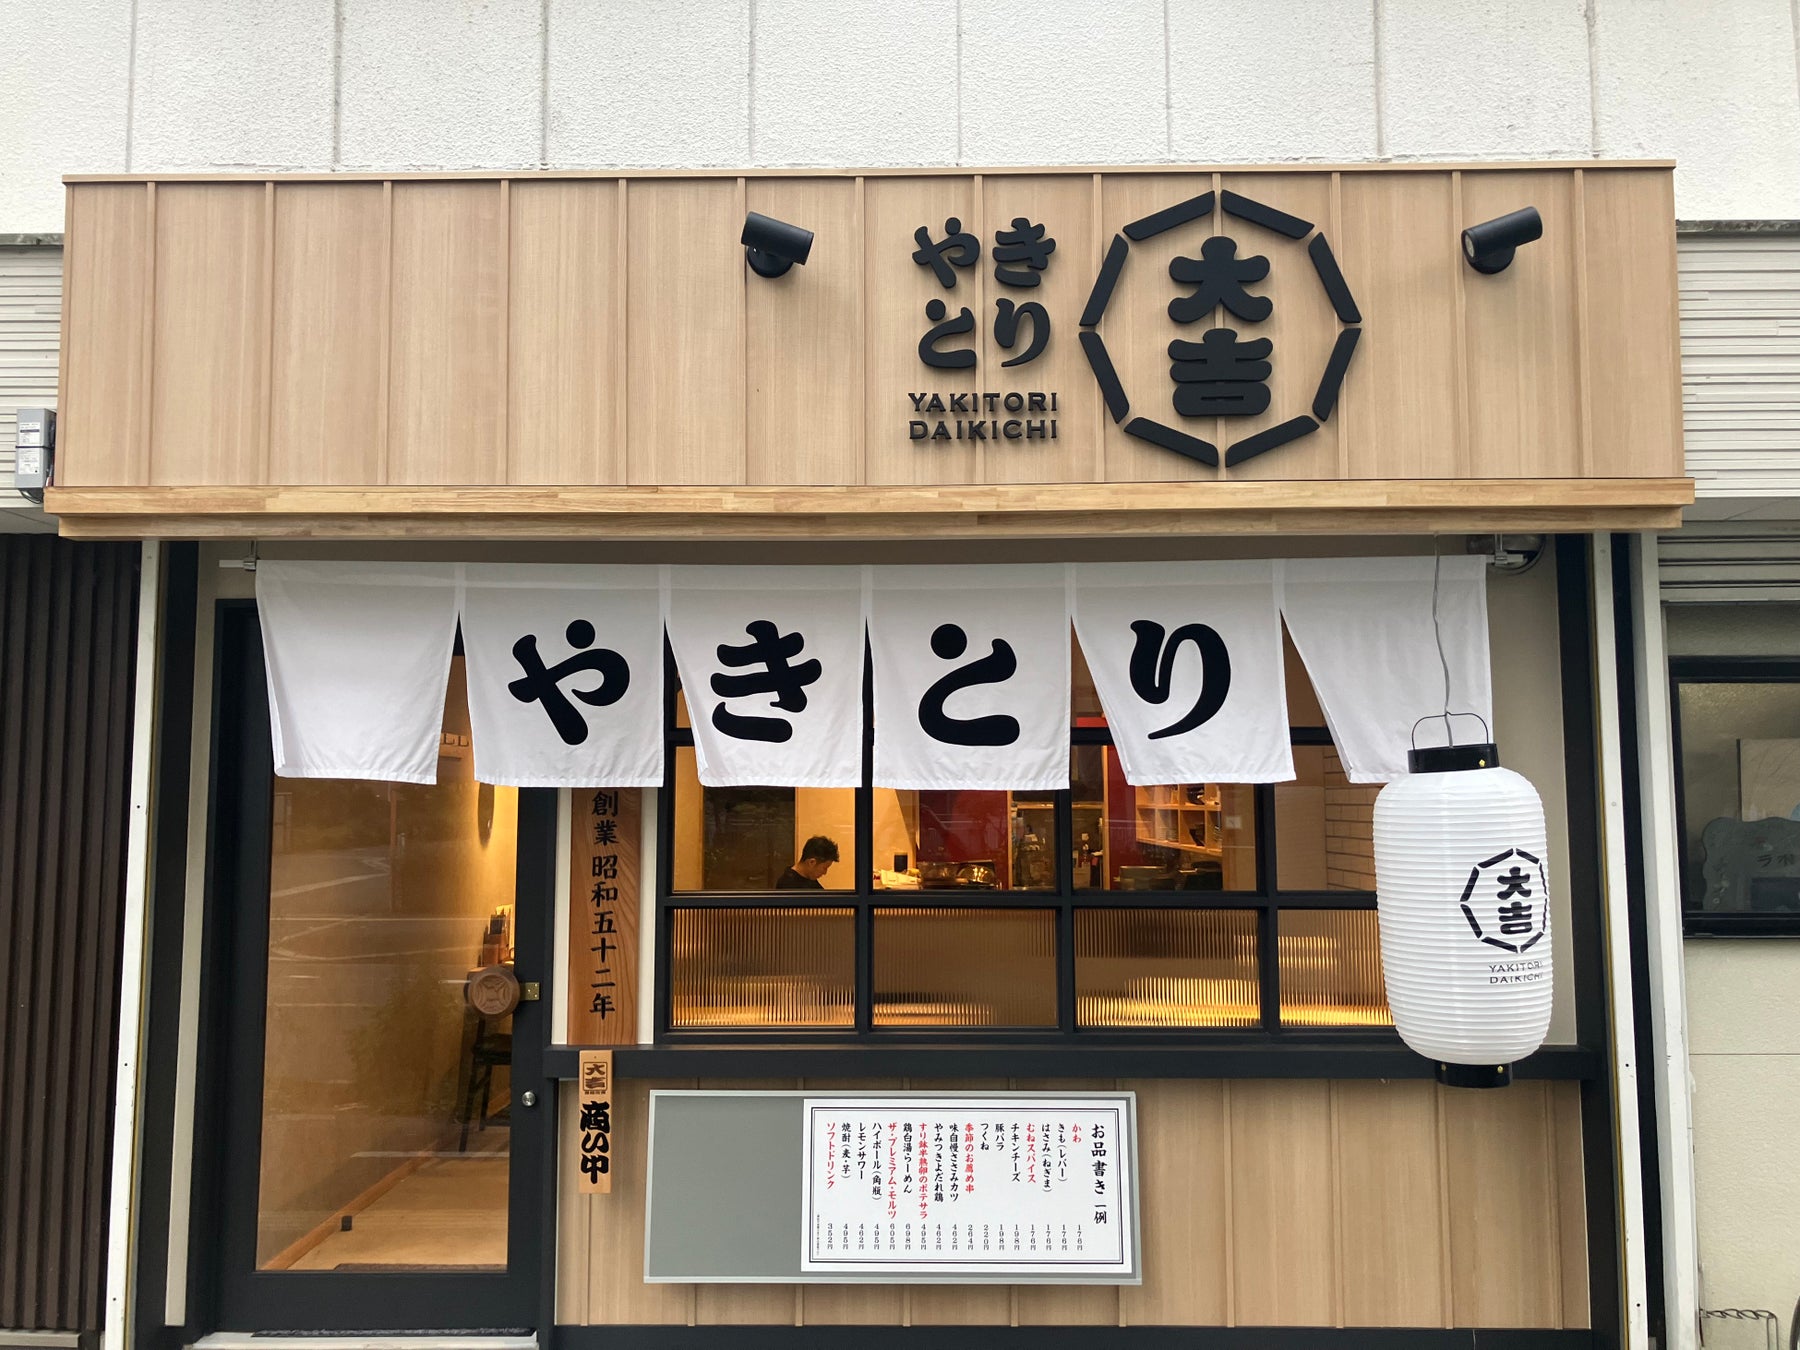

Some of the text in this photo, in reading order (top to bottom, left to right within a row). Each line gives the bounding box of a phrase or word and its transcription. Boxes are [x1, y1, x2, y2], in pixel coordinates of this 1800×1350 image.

[1167, 235, 1273, 417] 大吉
[908, 392, 1058, 412] YAKITORI
[909, 420, 1058, 440] DAIKICHI
[508, 619, 1231, 746] やきとり
[589, 790, 619, 1020] 創業 昭和五十二年
[1496, 866, 1533, 934] 大吉
[579, 1101, 611, 1184] 商い中
[826, 1123, 836, 1189] ソフトドリンク
[856, 1122, 867, 1179] レモンサワー
[902, 1123, 913, 1193] 鶏白湯らーめん
[948, 1123, 960, 1201] 味自慢ささみカツ
[979, 1123, 990, 1150] つくね
[994, 1123, 1006, 1151] 豚バラ
[1010, 1123, 1021, 1182] チキンチーズ
[1026, 1123, 1037, 1183] むねスパイス
[1071, 1124, 1082, 1143] かわ
[1091, 1124, 1107, 1224] お品書き 一例
